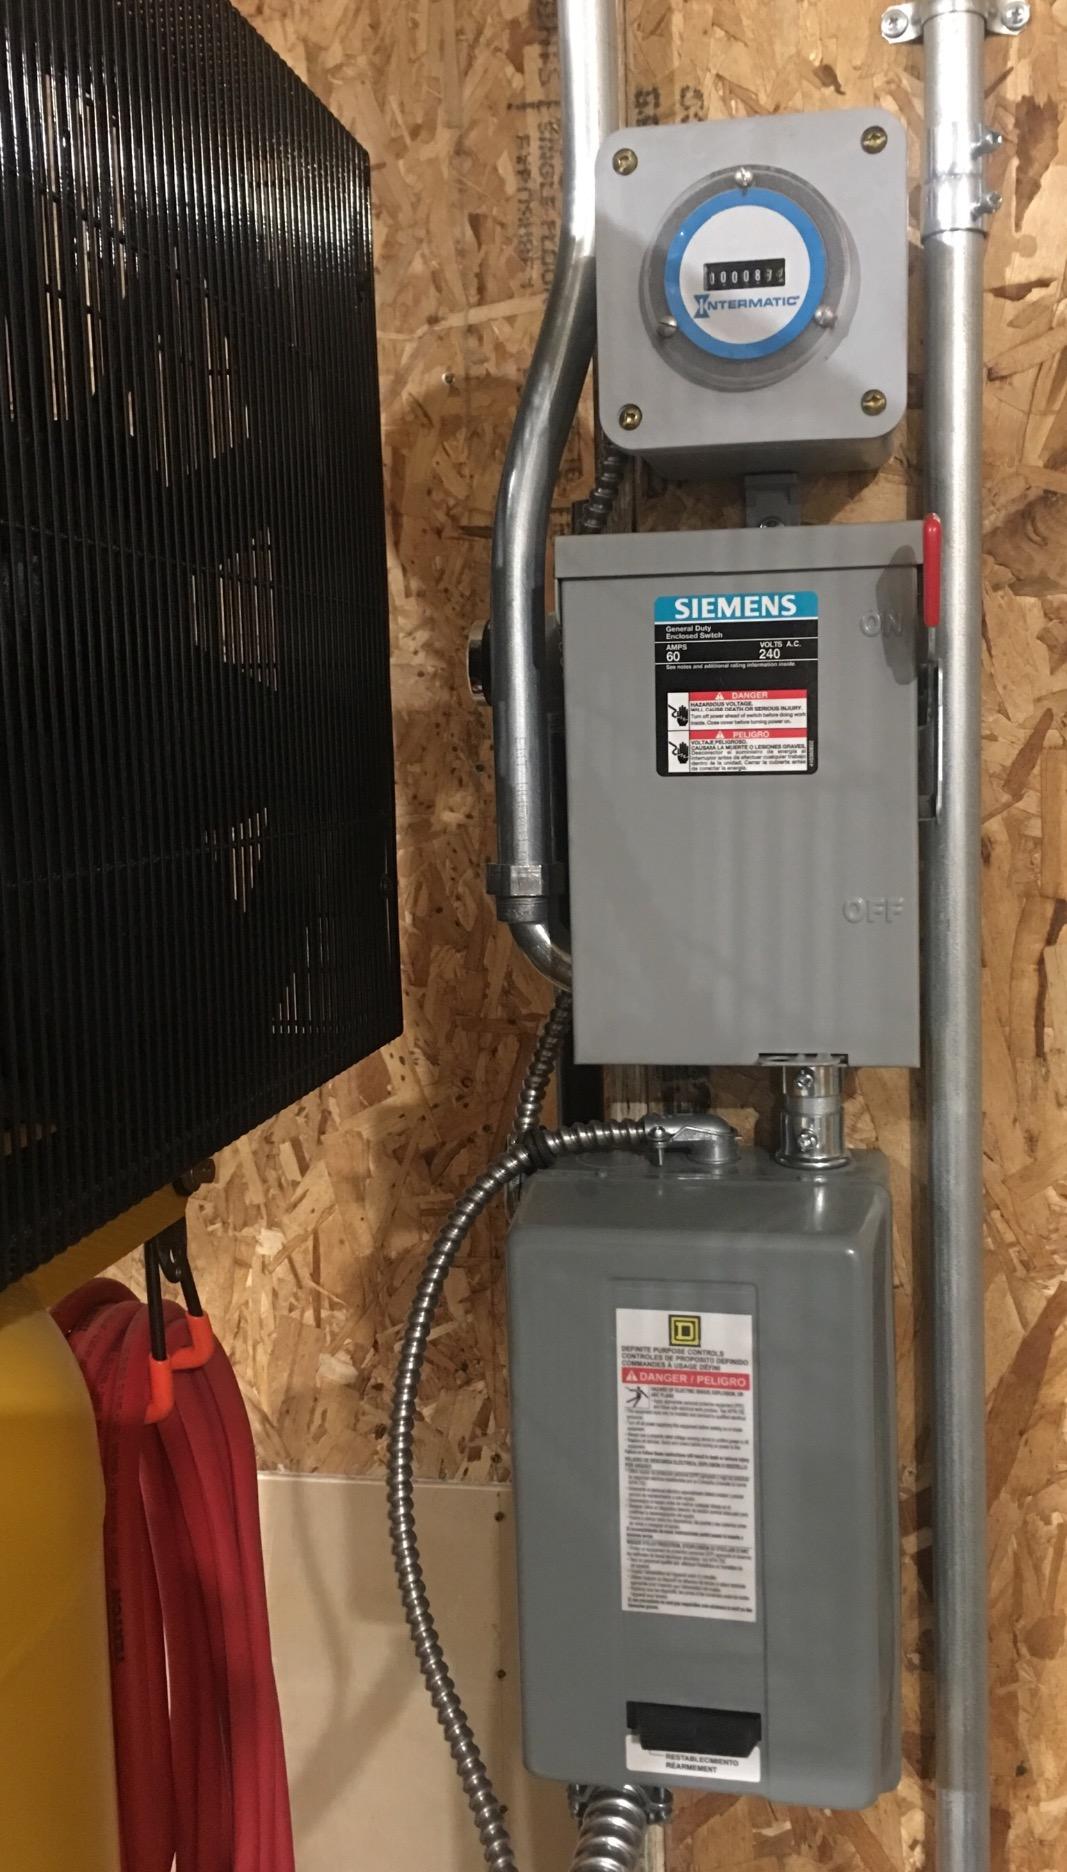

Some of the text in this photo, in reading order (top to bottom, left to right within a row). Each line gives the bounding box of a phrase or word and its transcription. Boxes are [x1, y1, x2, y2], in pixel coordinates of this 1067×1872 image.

[693, 294, 798, 319] INTERMATIC
[674, 595, 796, 619] SIEMENS
[859, 609, 903, 638] ON
[666, 651, 680, 661] 60
[759, 648, 780, 659] 240
[842, 897, 904, 924] OFF
[688, 1349, 724, 1357] CONTROLS
[621, 1360, 665, 1368] COMMANDES
[716, 1358, 749, 1366] DEFINIDO
[640, 1372, 688, 1383] DANGER
[696, 1375, 746, 1387] PELIGRO
[666, 1753, 739, 1766] RESTABLECIMIENTO
